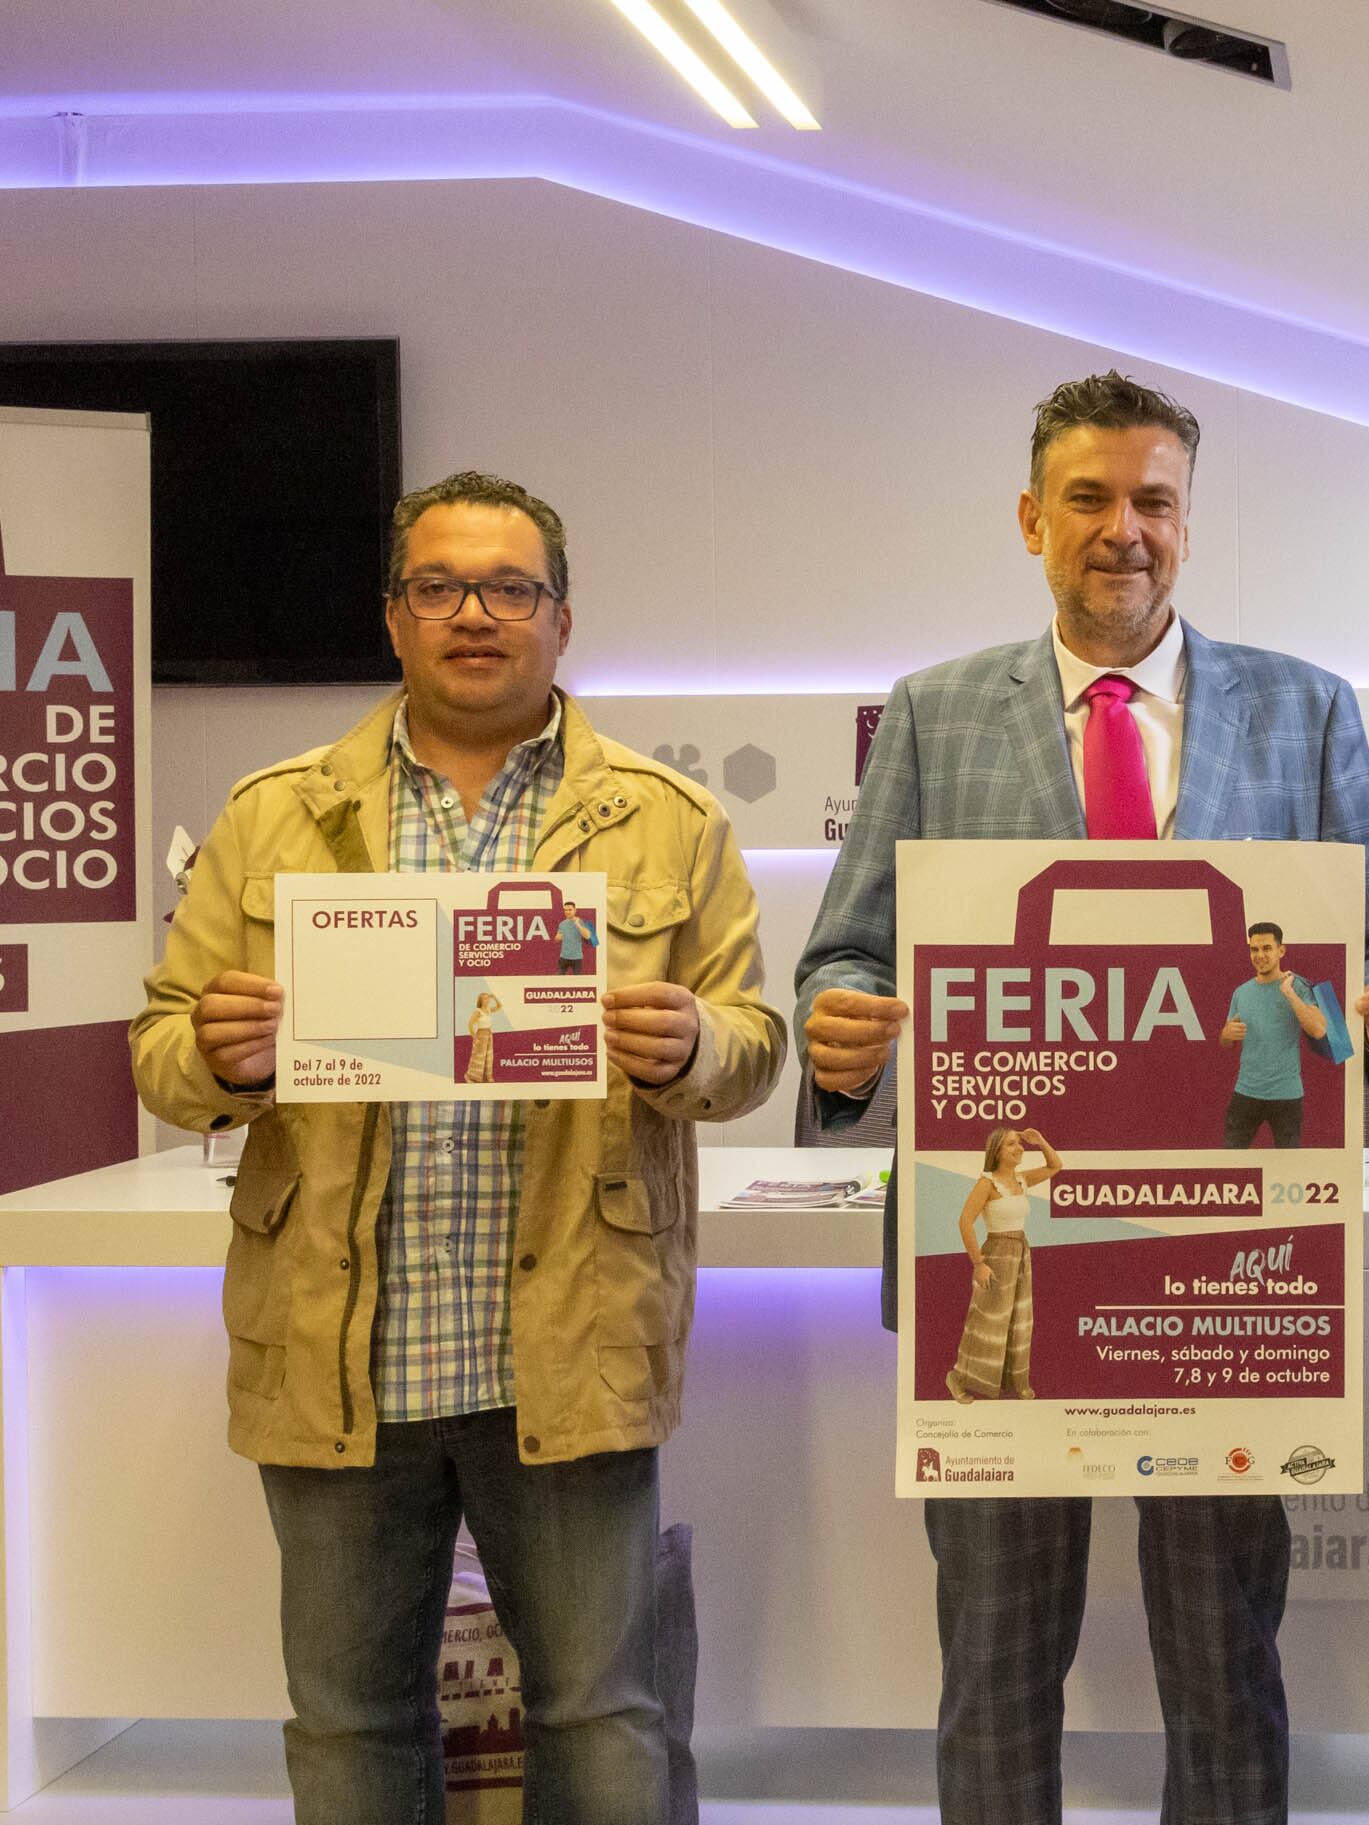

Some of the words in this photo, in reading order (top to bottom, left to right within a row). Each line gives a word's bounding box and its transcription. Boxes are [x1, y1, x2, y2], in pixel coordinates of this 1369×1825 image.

[46, 705, 115, 743] DE
[0, 849, 118, 889] CIO
[312, 910, 418, 929] OFERTAS
[458, 916, 551, 941] FERIA
[458, 943, 471, 951] DE
[473, 943, 522, 951] COMERCIO
[458, 951, 505, 959] SERVICIOS
[458, 959, 465, 967] Y
[467, 959, 491, 967] OCIO
[526, 991, 595, 999] GUADALAJARA
[930, 967, 1206, 1042] FERIA
[533, 1043, 541, 1051] lo
[544, 1043, 568, 1051] tienes
[570, 1043, 589, 1051] todo
[294, 1059, 311, 1071] Del
[315, 1059, 322, 1071] 7
[325, 1059, 336, 1070] al
[340, 1059, 346, 1070] 9
[350, 1058, 363, 1070] de
[542, 1058, 593, 1066] MULTIUSOS
[932, 1052, 965, 1072] DE
[974, 1050, 1118, 1073] COMERCIO
[293, 1074, 334, 1086] octubre
[337, 1074, 351, 1085] de
[354, 1073, 381, 1085] 2022
[931, 1075, 1066, 1097] SERVICIOS
[931, 1100, 951, 1119] Y
[956, 1099, 1027, 1120] OCIO
[1053, 1183, 1260, 1206] GUADALAJARA
[1270, 1183, 1339, 1205] 2022
[1230, 1235, 1294, 1286] AQUÍ
[1164, 1275, 1186, 1295] lo
[1192, 1276, 1259, 1295] tienes
[1266, 1275, 1318, 1295] todo
[1078, 1316, 1183, 1337] PALACIO
[1191, 1316, 1331, 1337] MULTIUSOS
[1096, 1346, 1165, 1363] Viernes,
[1171, 1344, 1234, 1361] sábado
[1239, 1349, 1249, 1364] y
[1254, 1344, 1330, 1364] domingo
[1174, 1368, 1201, 1386] 7,8
[1207, 1372, 1217, 1386] y
[1222, 1367, 1232, 1382] 9
[1239, 1367, 1260, 1383] de
[1266, 1367, 1330, 1383] octubre
[1065, 1404, 1196, 1418] www.guadalajara.es
[962, 1430, 972, 1438] de
[974, 1430, 1014, 1438] Comercio
[1066, 1428, 1076, 1437] En
[945, 1455, 1002, 1466] Ayuntamiento
[1004, 1455, 1015, 1464] de
[945, 1468, 1014, 1482] Guadalajara
